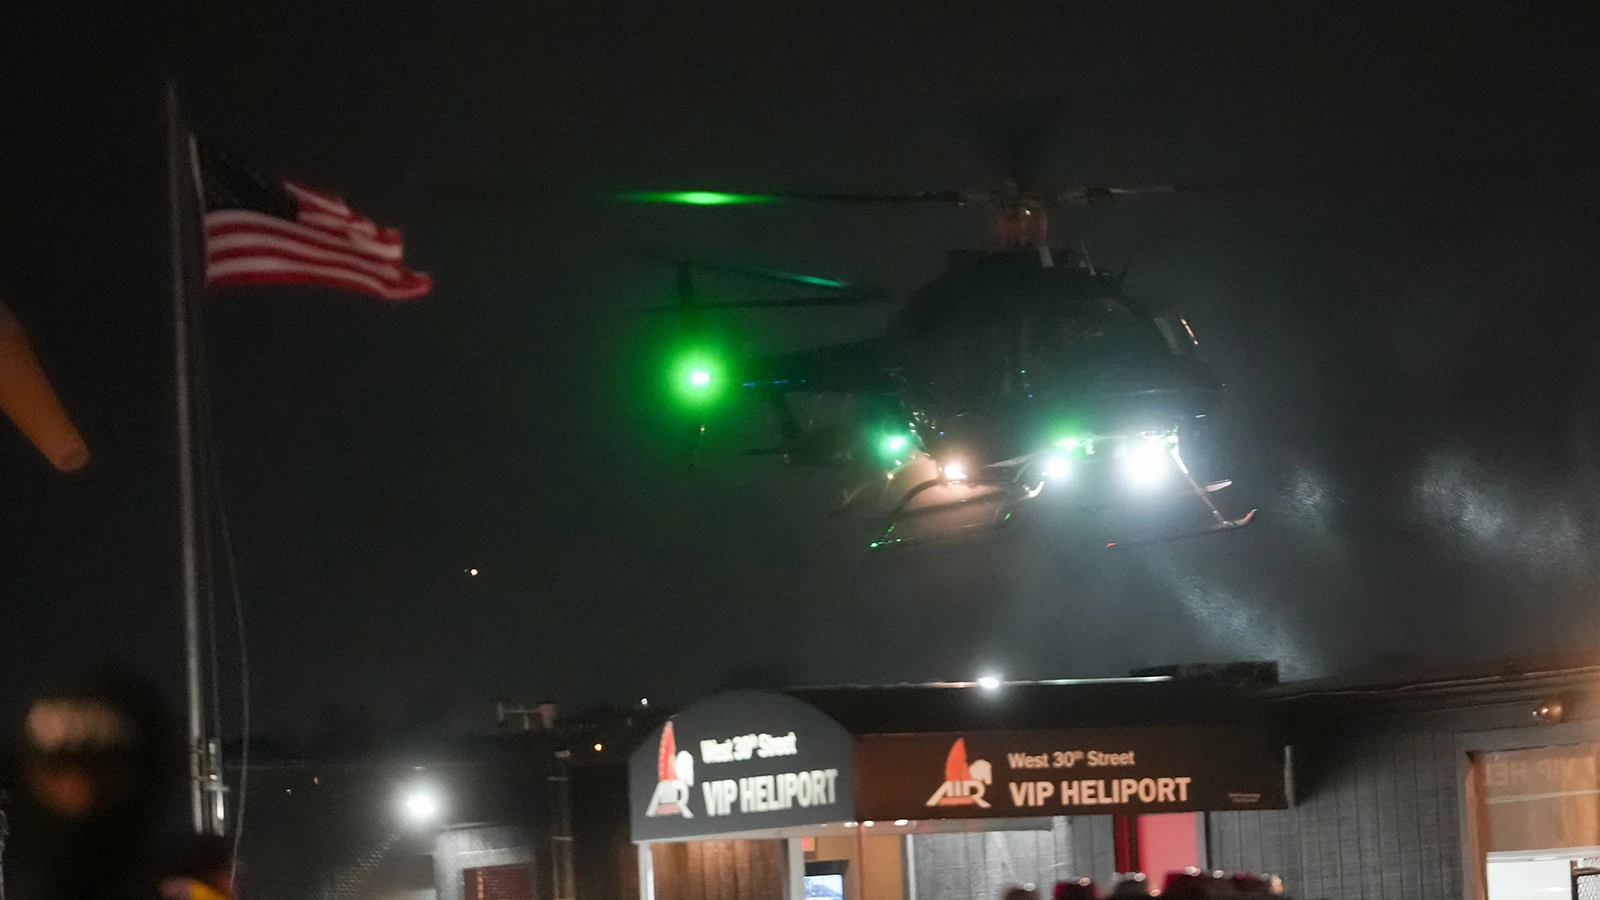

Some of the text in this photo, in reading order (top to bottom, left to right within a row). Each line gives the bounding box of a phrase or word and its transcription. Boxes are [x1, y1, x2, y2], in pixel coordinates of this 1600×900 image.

[1007, 752, 1050, 769] West
[1087, 750, 1136, 766] Street
[702, 768, 839, 817] VIP HELIPORT
[926, 779, 992, 809] AIR
[1008, 776, 1192, 807] VIP HELIPORT
